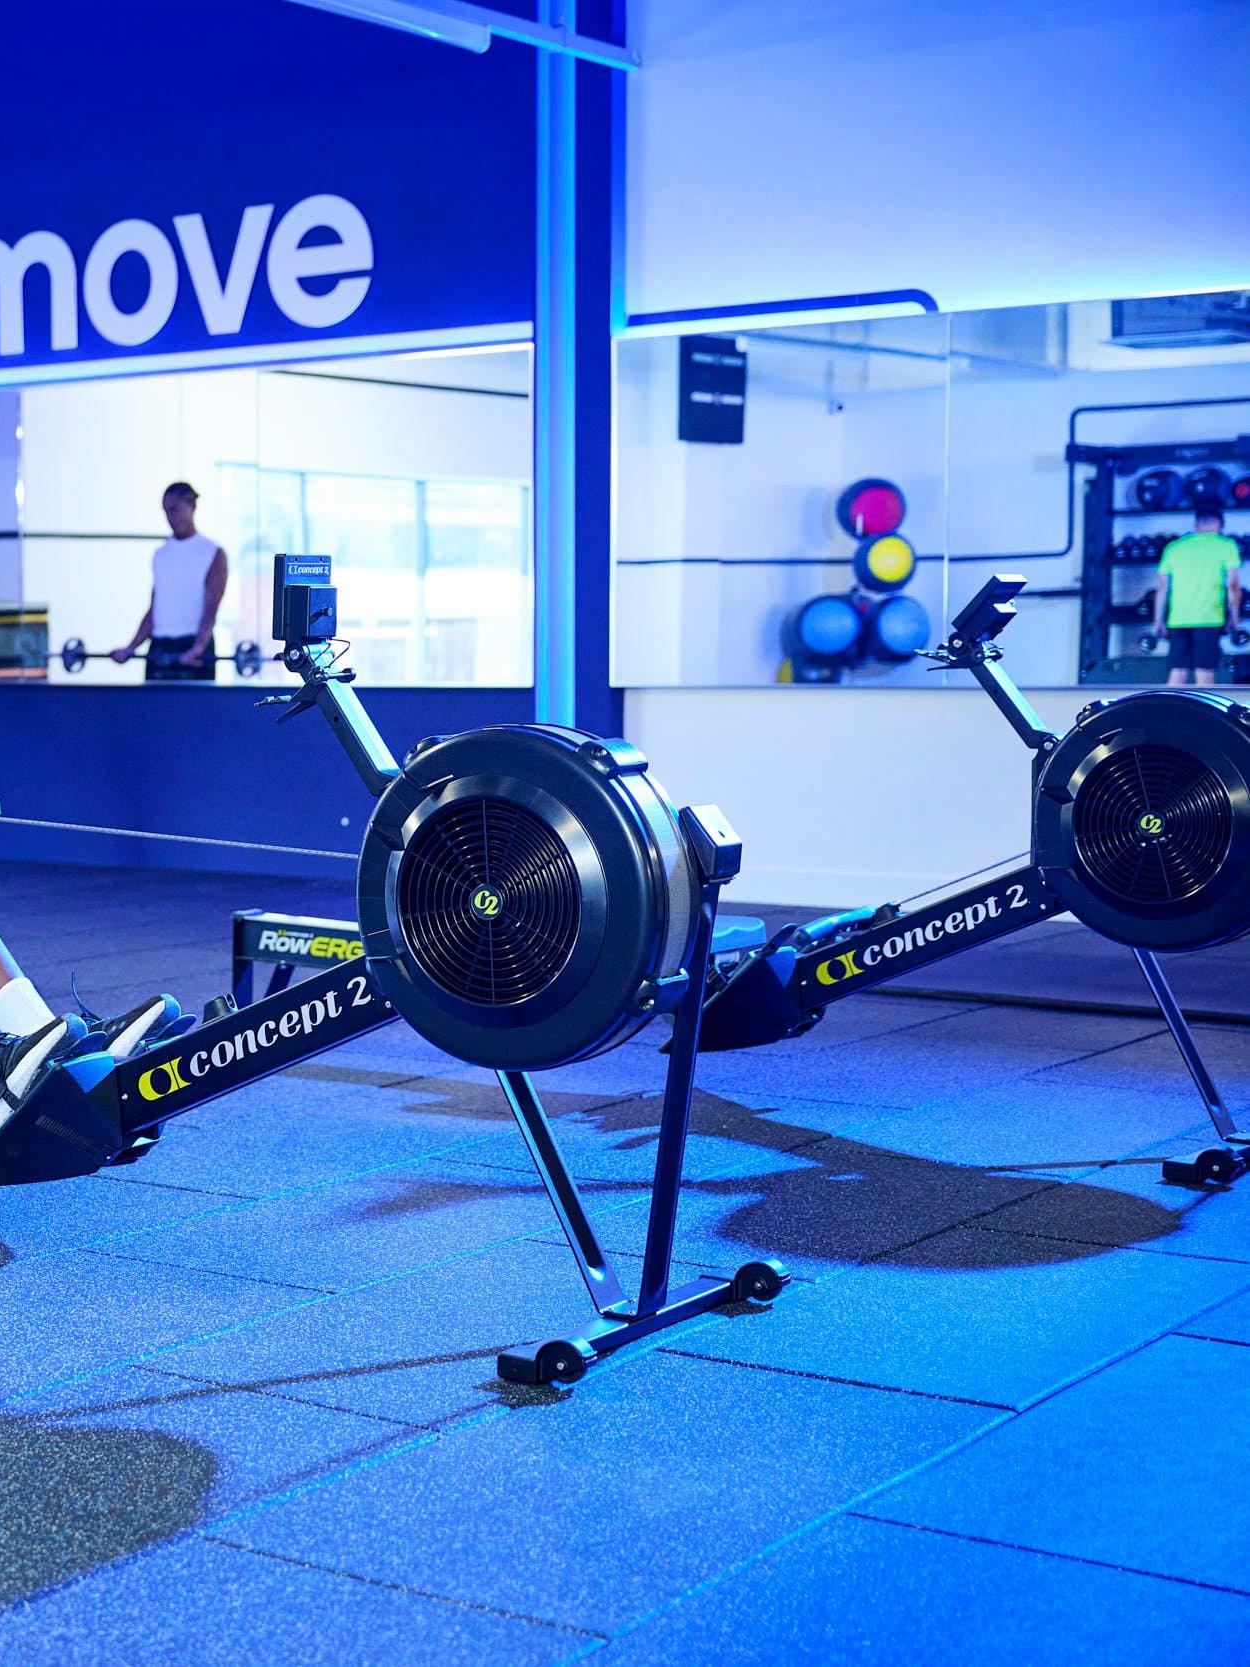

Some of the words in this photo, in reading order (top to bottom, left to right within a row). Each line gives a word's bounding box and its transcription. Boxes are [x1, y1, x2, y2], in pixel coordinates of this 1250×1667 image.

[297, 566, 323, 574] concept
[1140, 814, 1162, 834] C2
[474, 890, 499, 915] C2
[863, 895, 1002, 966] concept
[1006, 884, 1029, 909] 2
[189, 990, 343, 1078] concept
[346, 976, 372, 1007] 2
